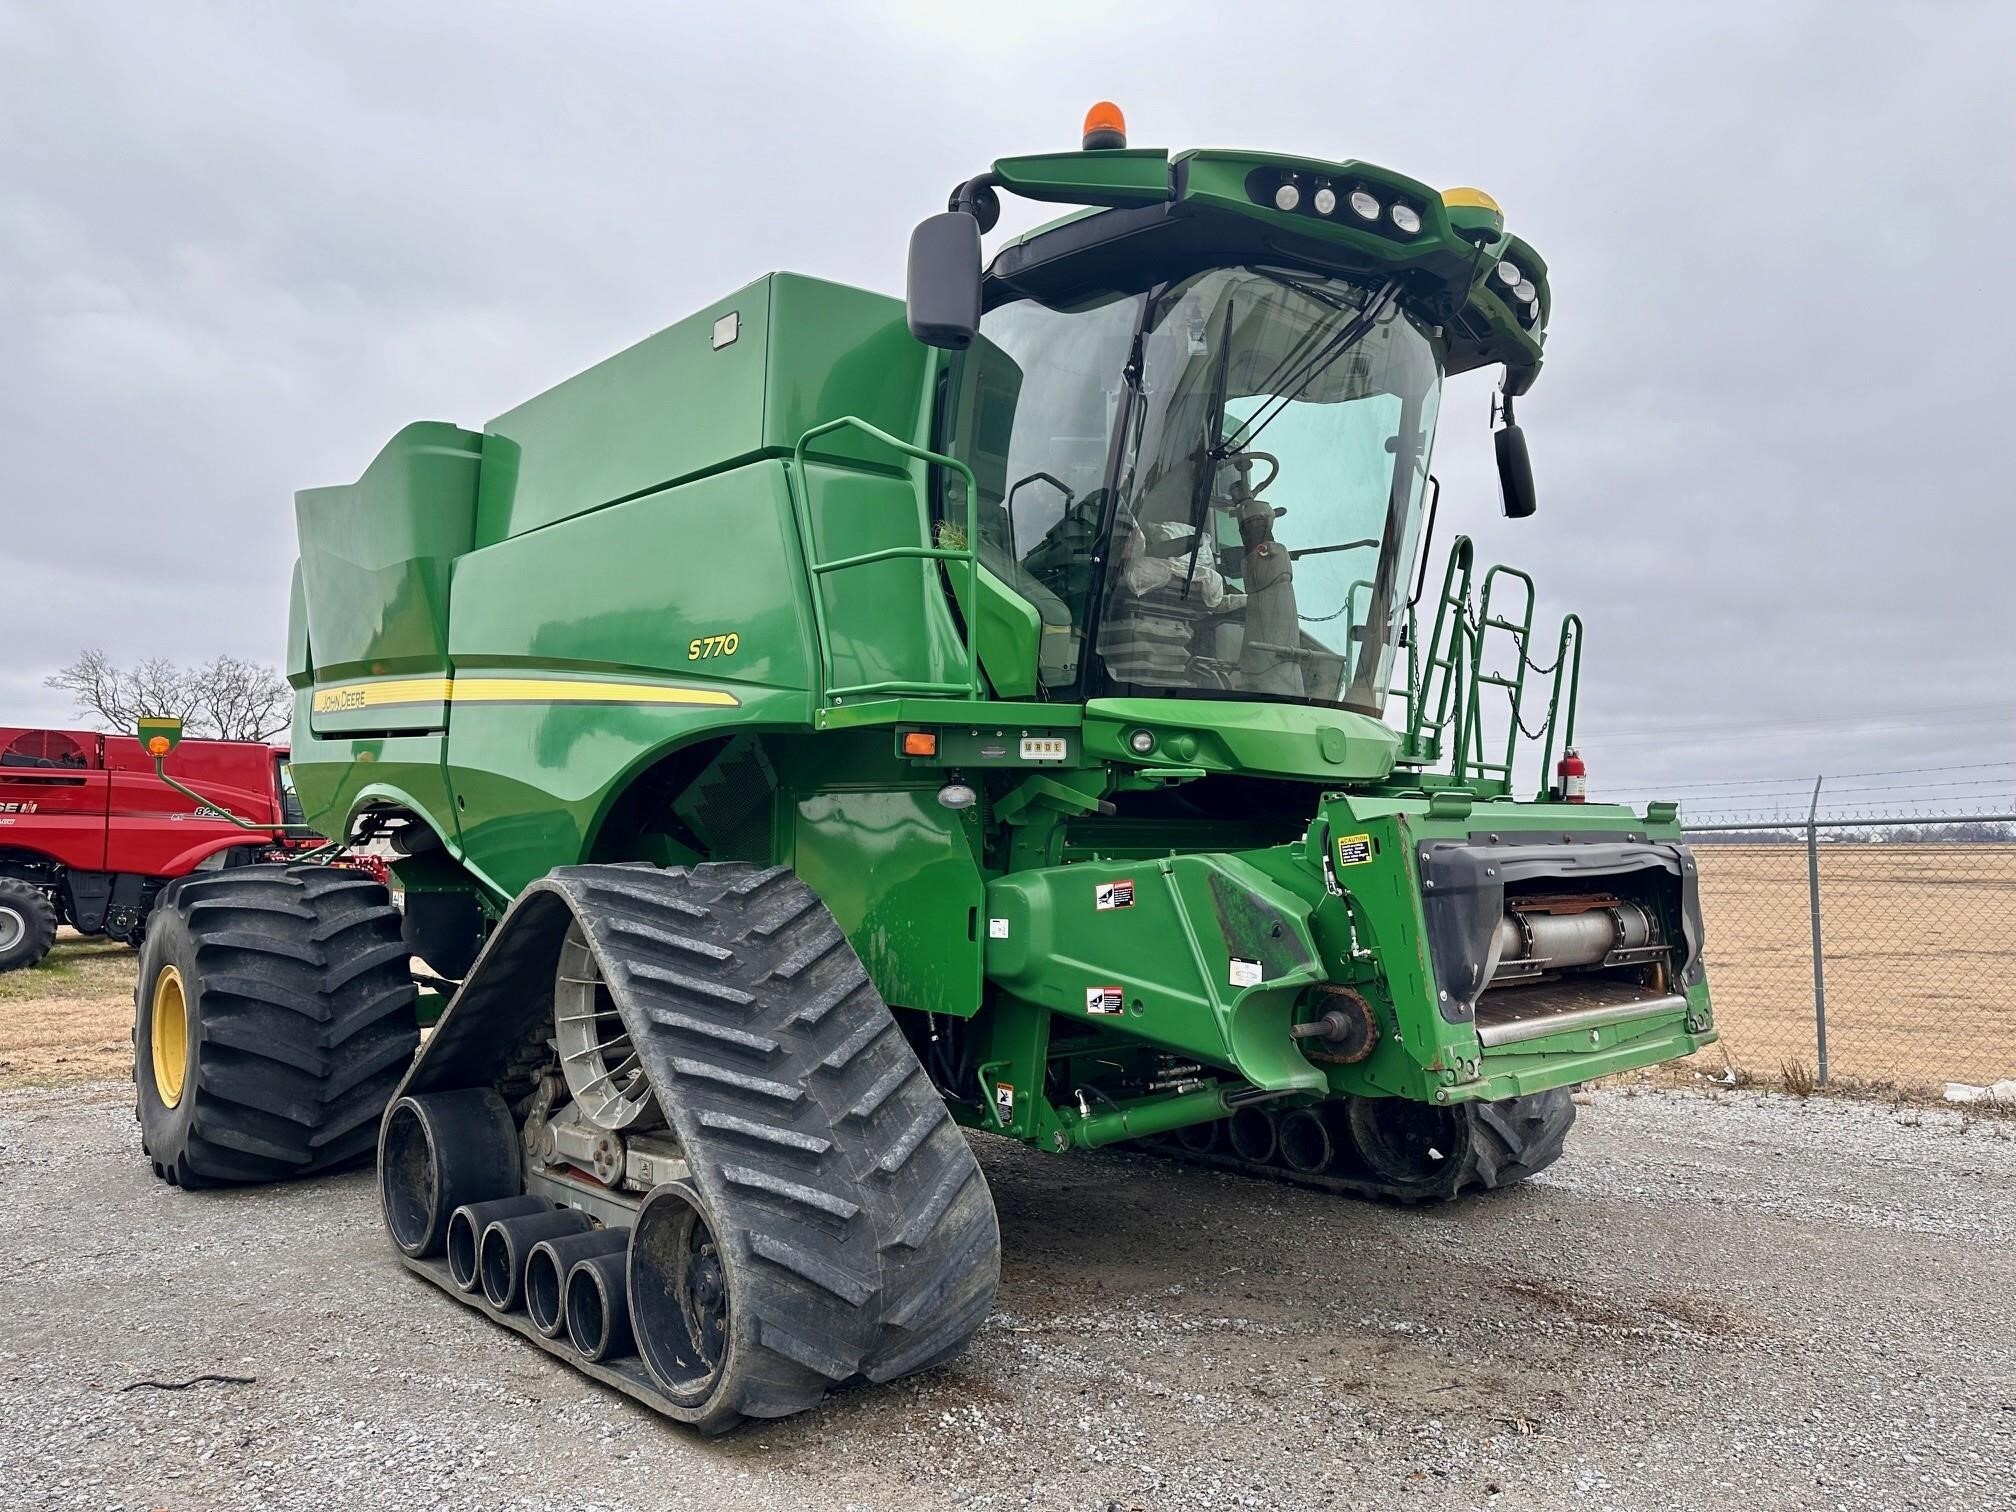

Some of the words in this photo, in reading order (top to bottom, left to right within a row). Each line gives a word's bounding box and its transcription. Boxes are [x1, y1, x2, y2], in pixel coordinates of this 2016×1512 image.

[688, 632, 739, 660] S770
[321, 693, 341, 710] JOHN
[341, 691, 366, 707] DEERE
[1345, 835, 1368, 843] CAUTION
